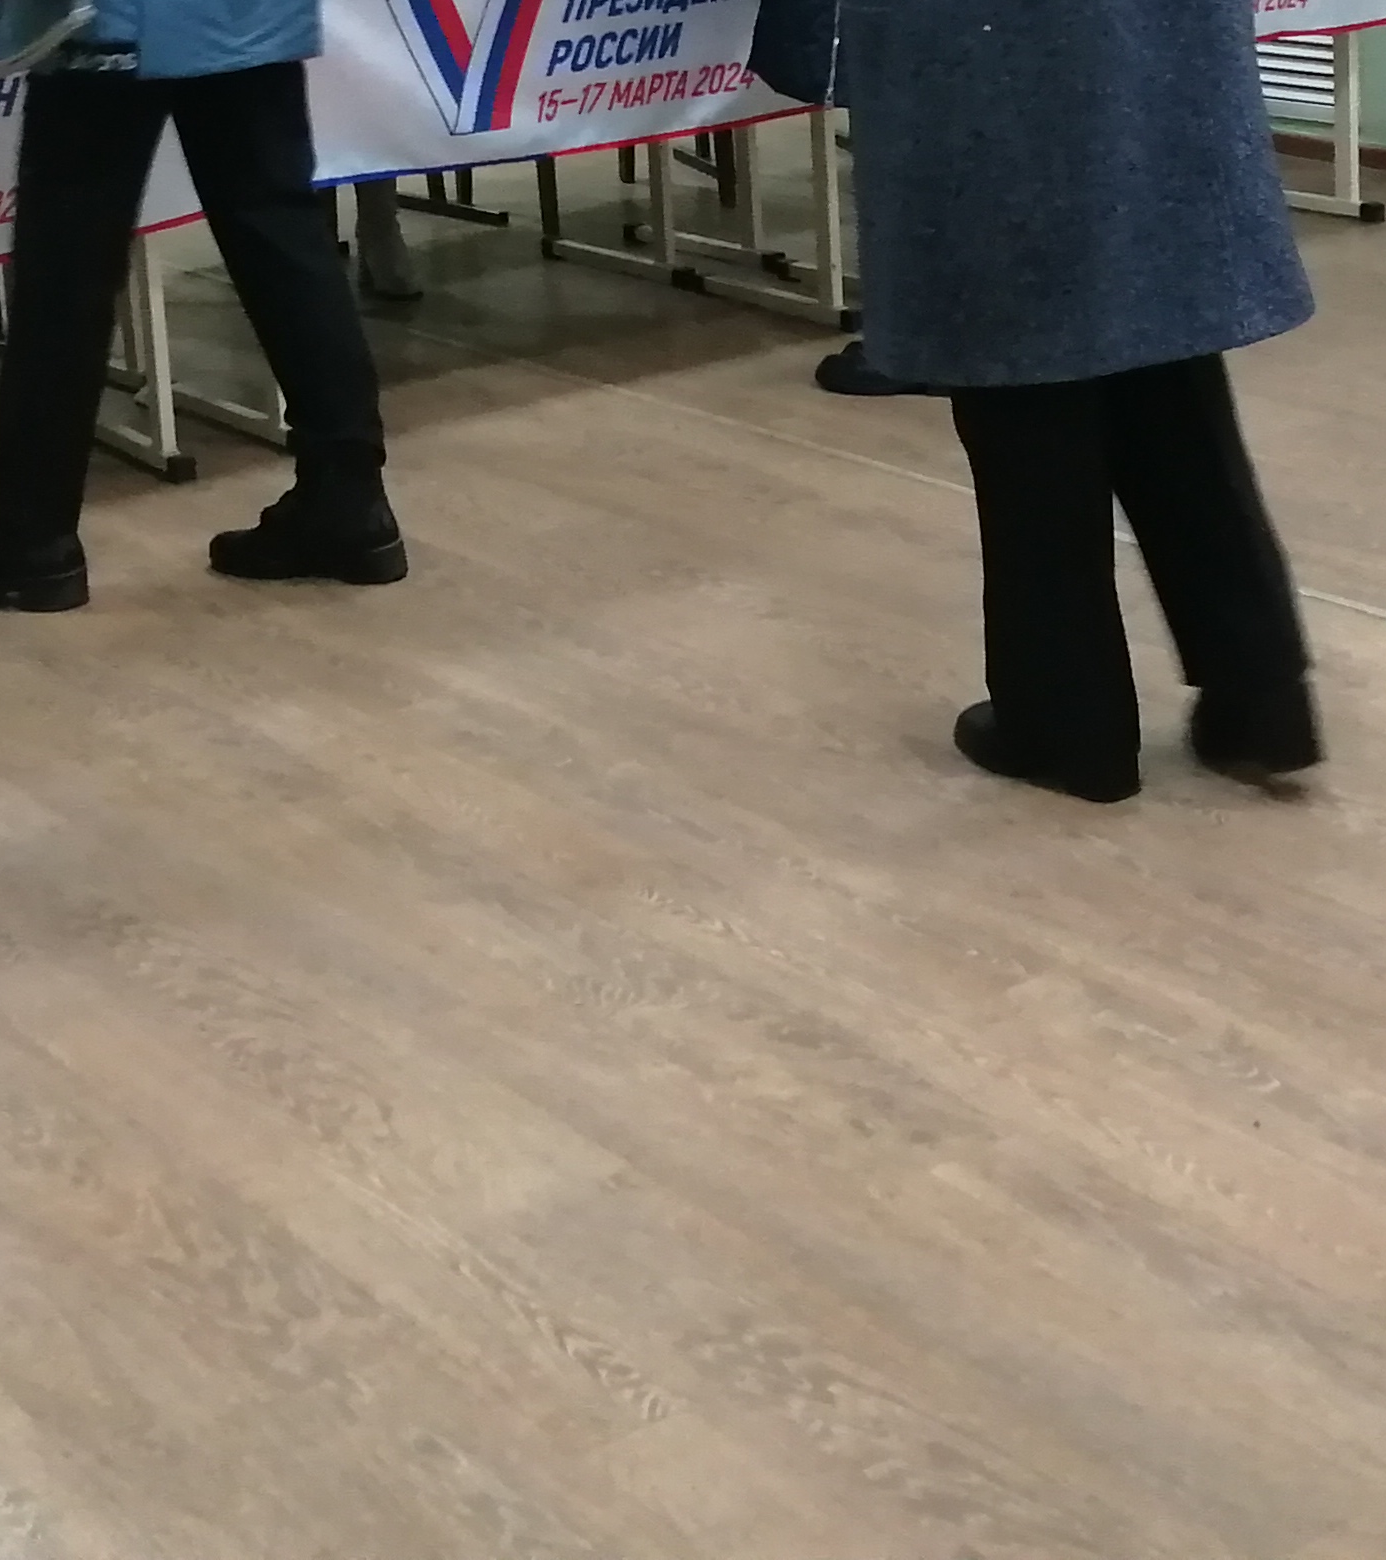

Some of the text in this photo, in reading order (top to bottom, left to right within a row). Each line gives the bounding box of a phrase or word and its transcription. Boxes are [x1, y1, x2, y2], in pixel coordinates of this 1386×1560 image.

[546, 21, 682, 76] РОССИИ
[608, 69, 688, 113] МАРТА
[692, 62, 754, 96] 2024
